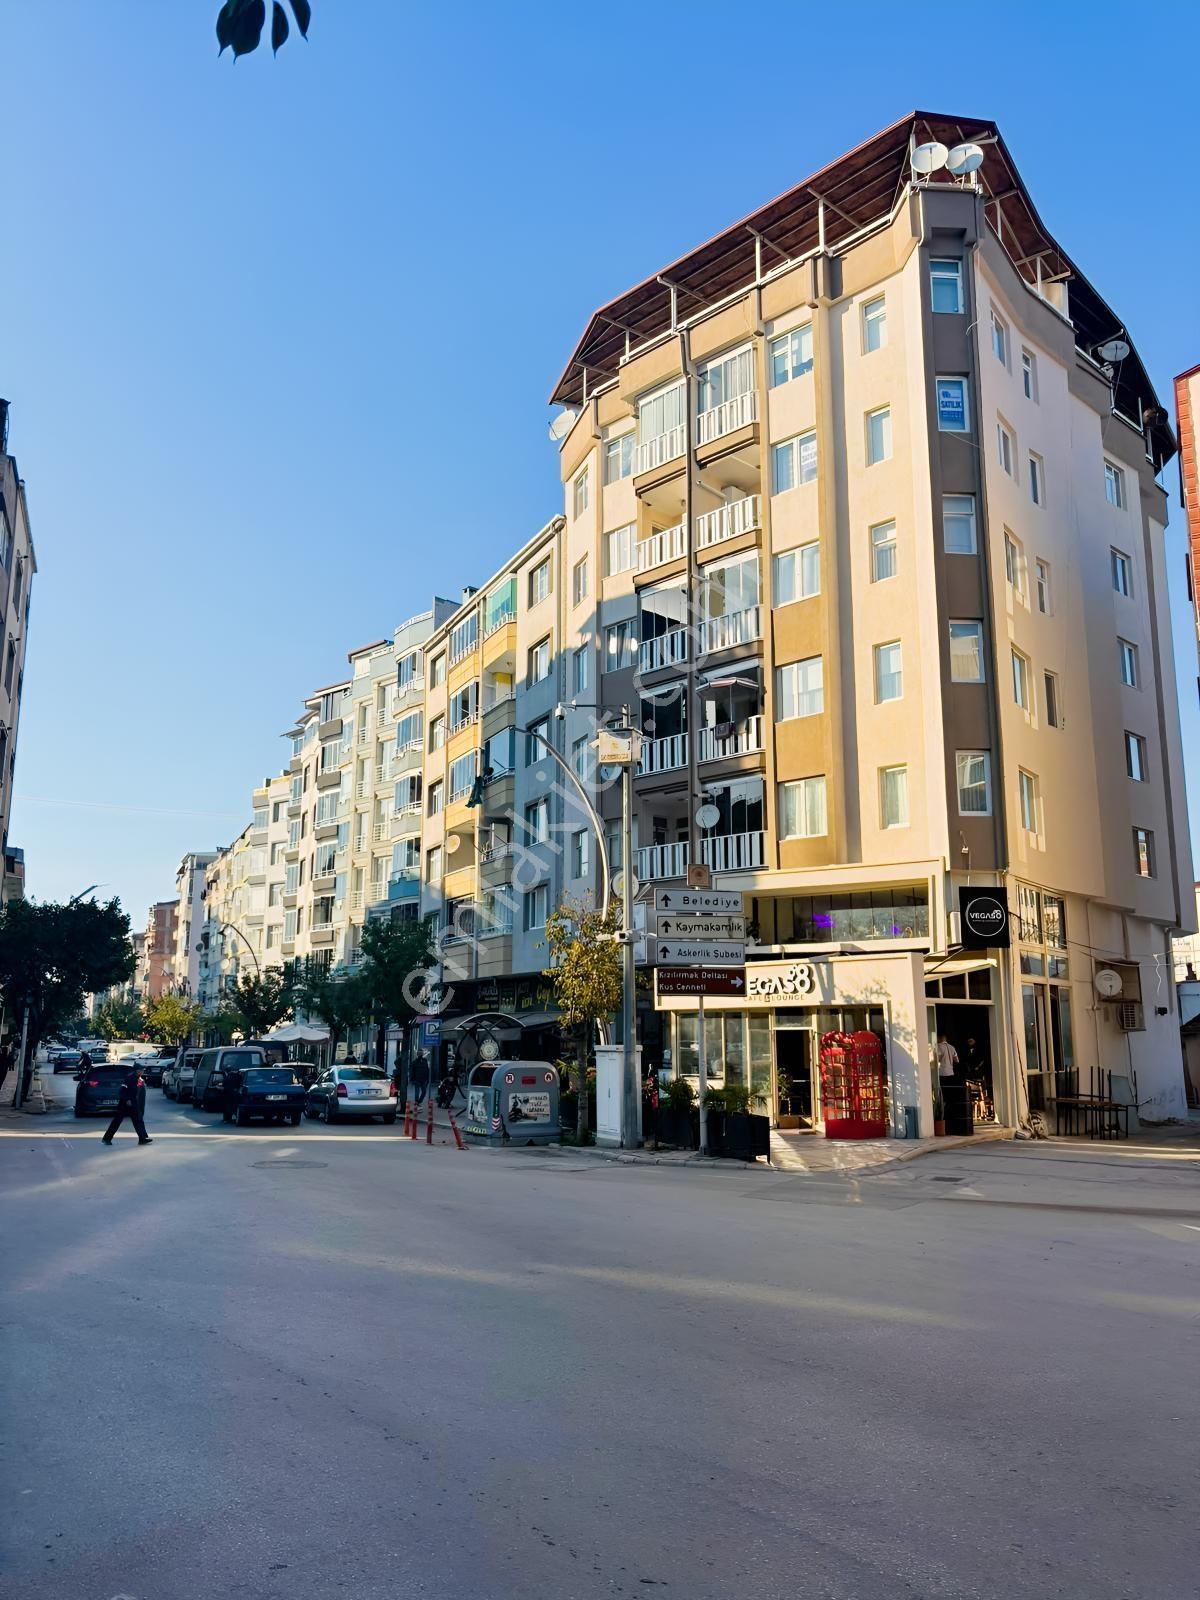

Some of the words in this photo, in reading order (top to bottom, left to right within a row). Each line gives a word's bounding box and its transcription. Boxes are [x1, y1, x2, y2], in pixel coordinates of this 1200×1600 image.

[682, 896, 740, 909] Belediye
[677, 948, 711, 958] Askerlik
[676, 983, 706, 991] Cenneti
